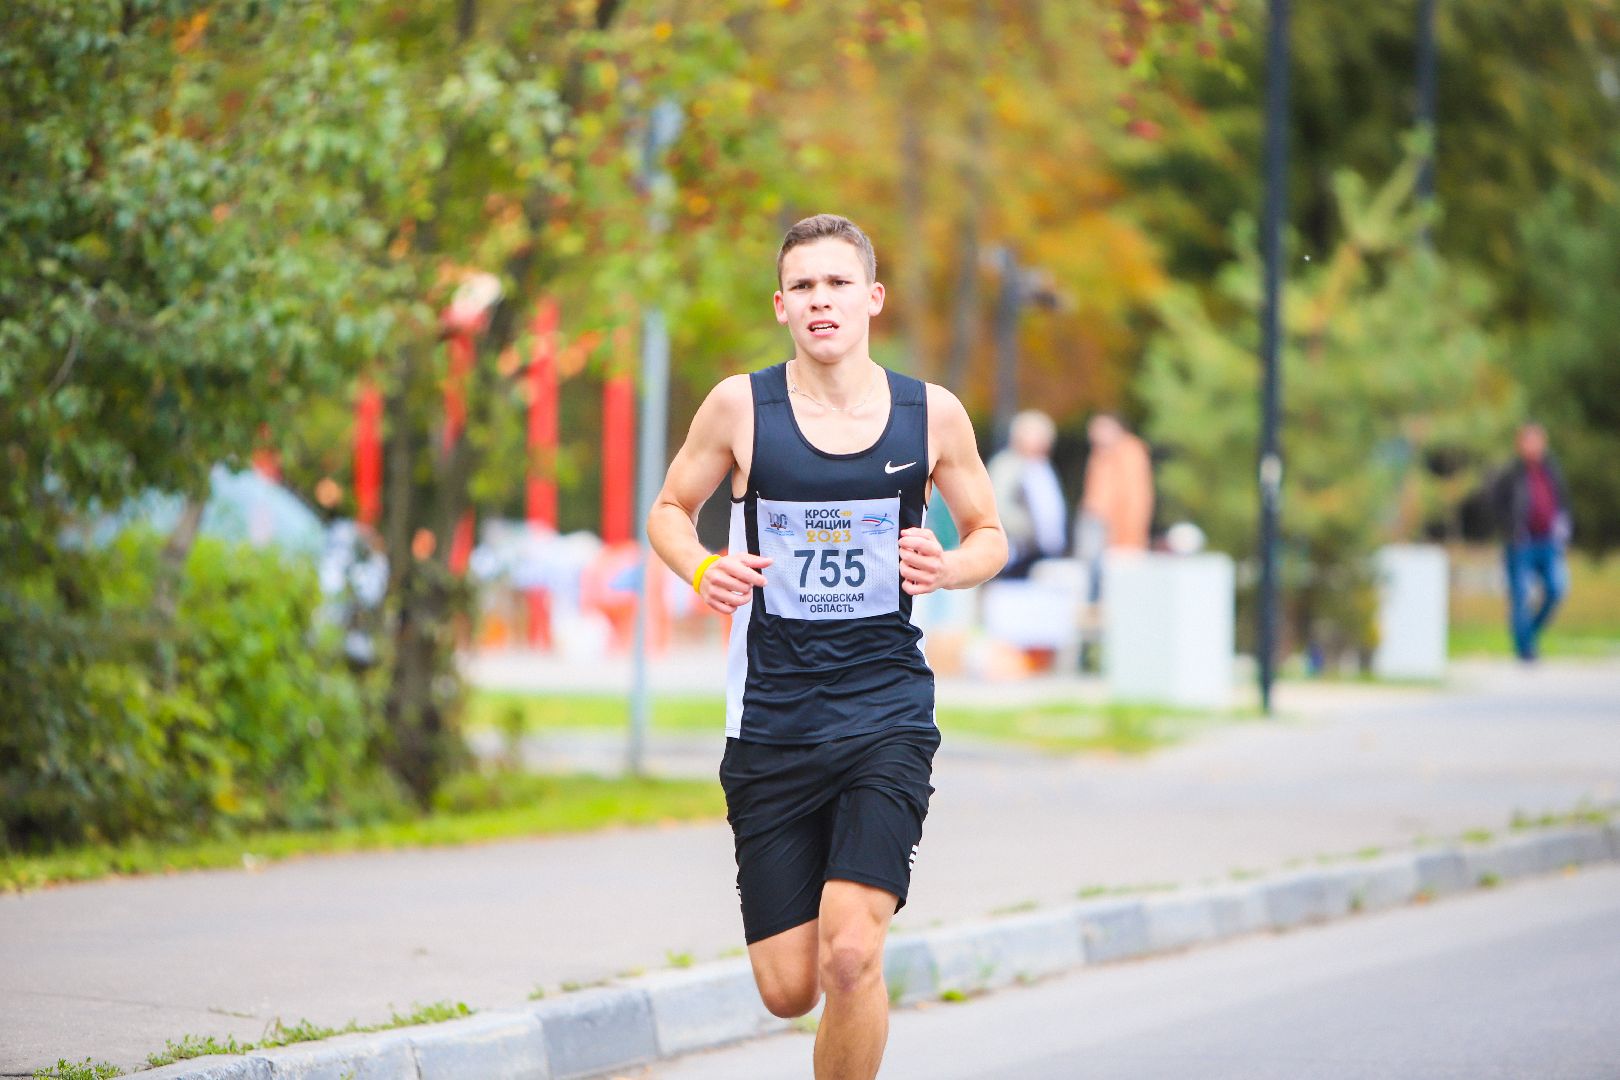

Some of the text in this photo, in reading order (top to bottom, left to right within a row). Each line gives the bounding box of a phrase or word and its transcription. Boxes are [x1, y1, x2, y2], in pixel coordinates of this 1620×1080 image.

[805, 509, 840, 519] КРОСС
[805, 519, 851, 530] НАЦИИ
[806, 530, 852, 543] 2023
[794, 549, 866, 588] 755
[799, 593, 864, 603] МОСКОВСКАЯ
[809, 604, 855, 613] ОБЛАСТЬ
